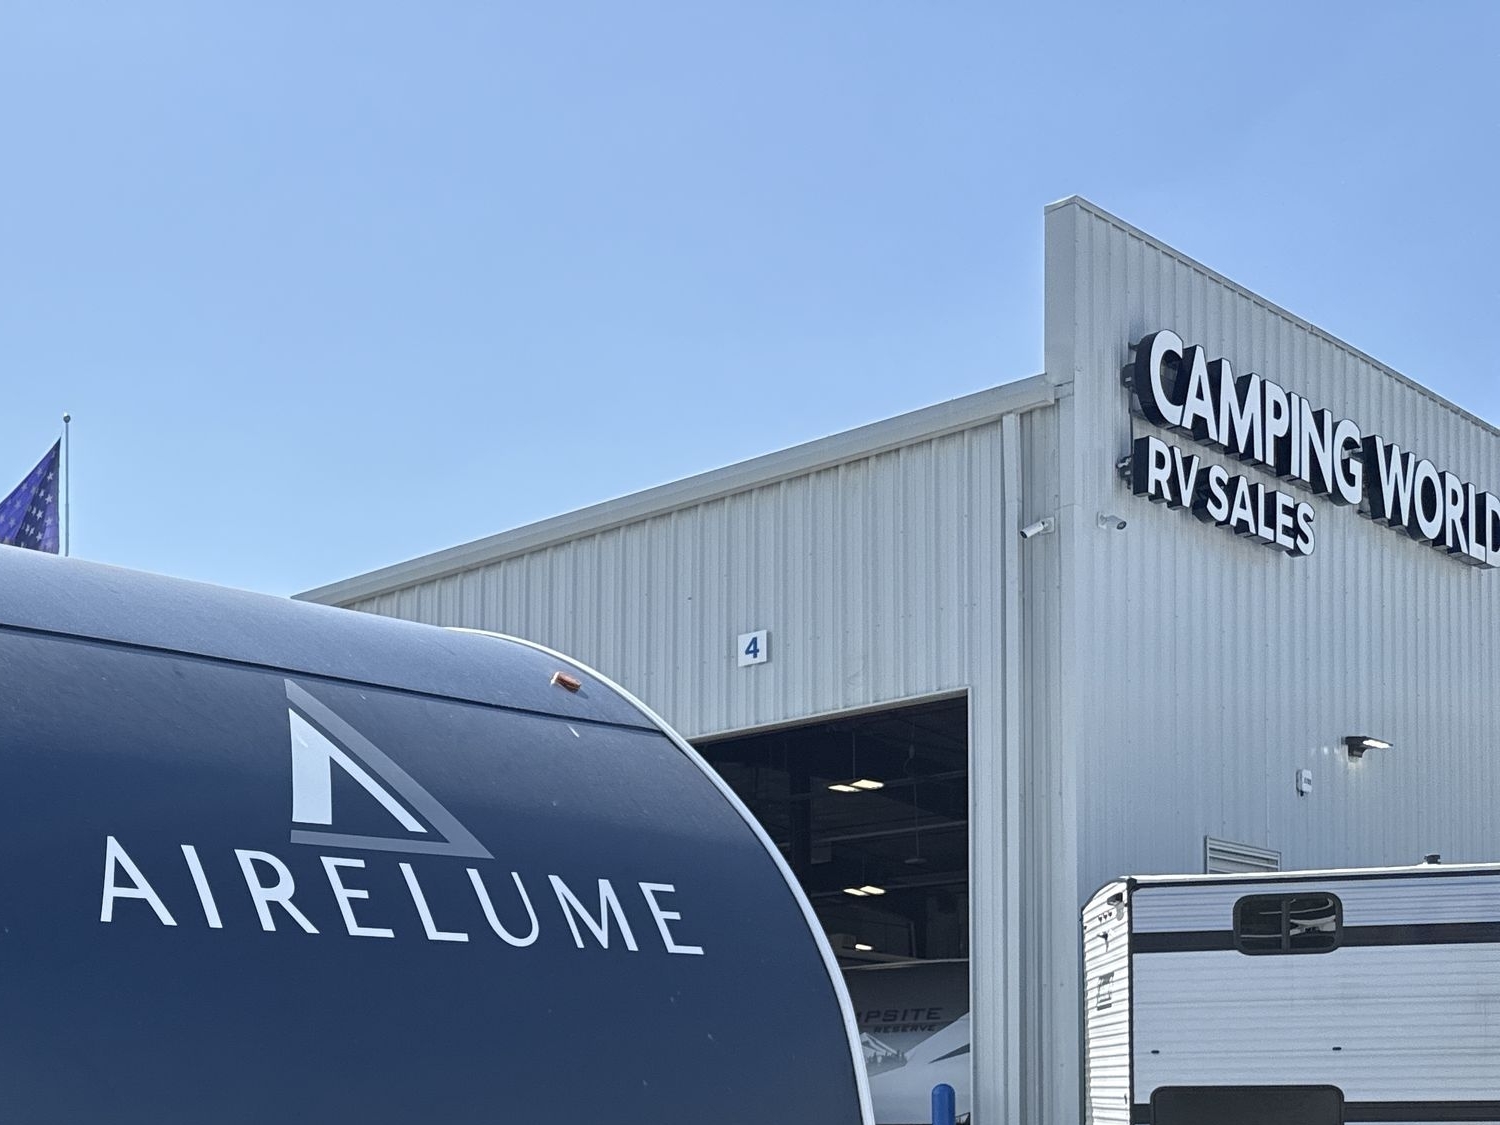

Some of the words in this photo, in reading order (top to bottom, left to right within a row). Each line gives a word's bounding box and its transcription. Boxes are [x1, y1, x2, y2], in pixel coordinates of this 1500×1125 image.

[1146, 329, 1363, 505] CAMPING
[1372, 434, 1500, 569] WORLD
[1146, 436, 1200, 509] RV
[1205, 464, 1316, 556] SALES
[744, 636, 760, 659] 4
[100, 836, 704, 955] AIRELUME
[857, 1007, 943, 1023] PSITE
